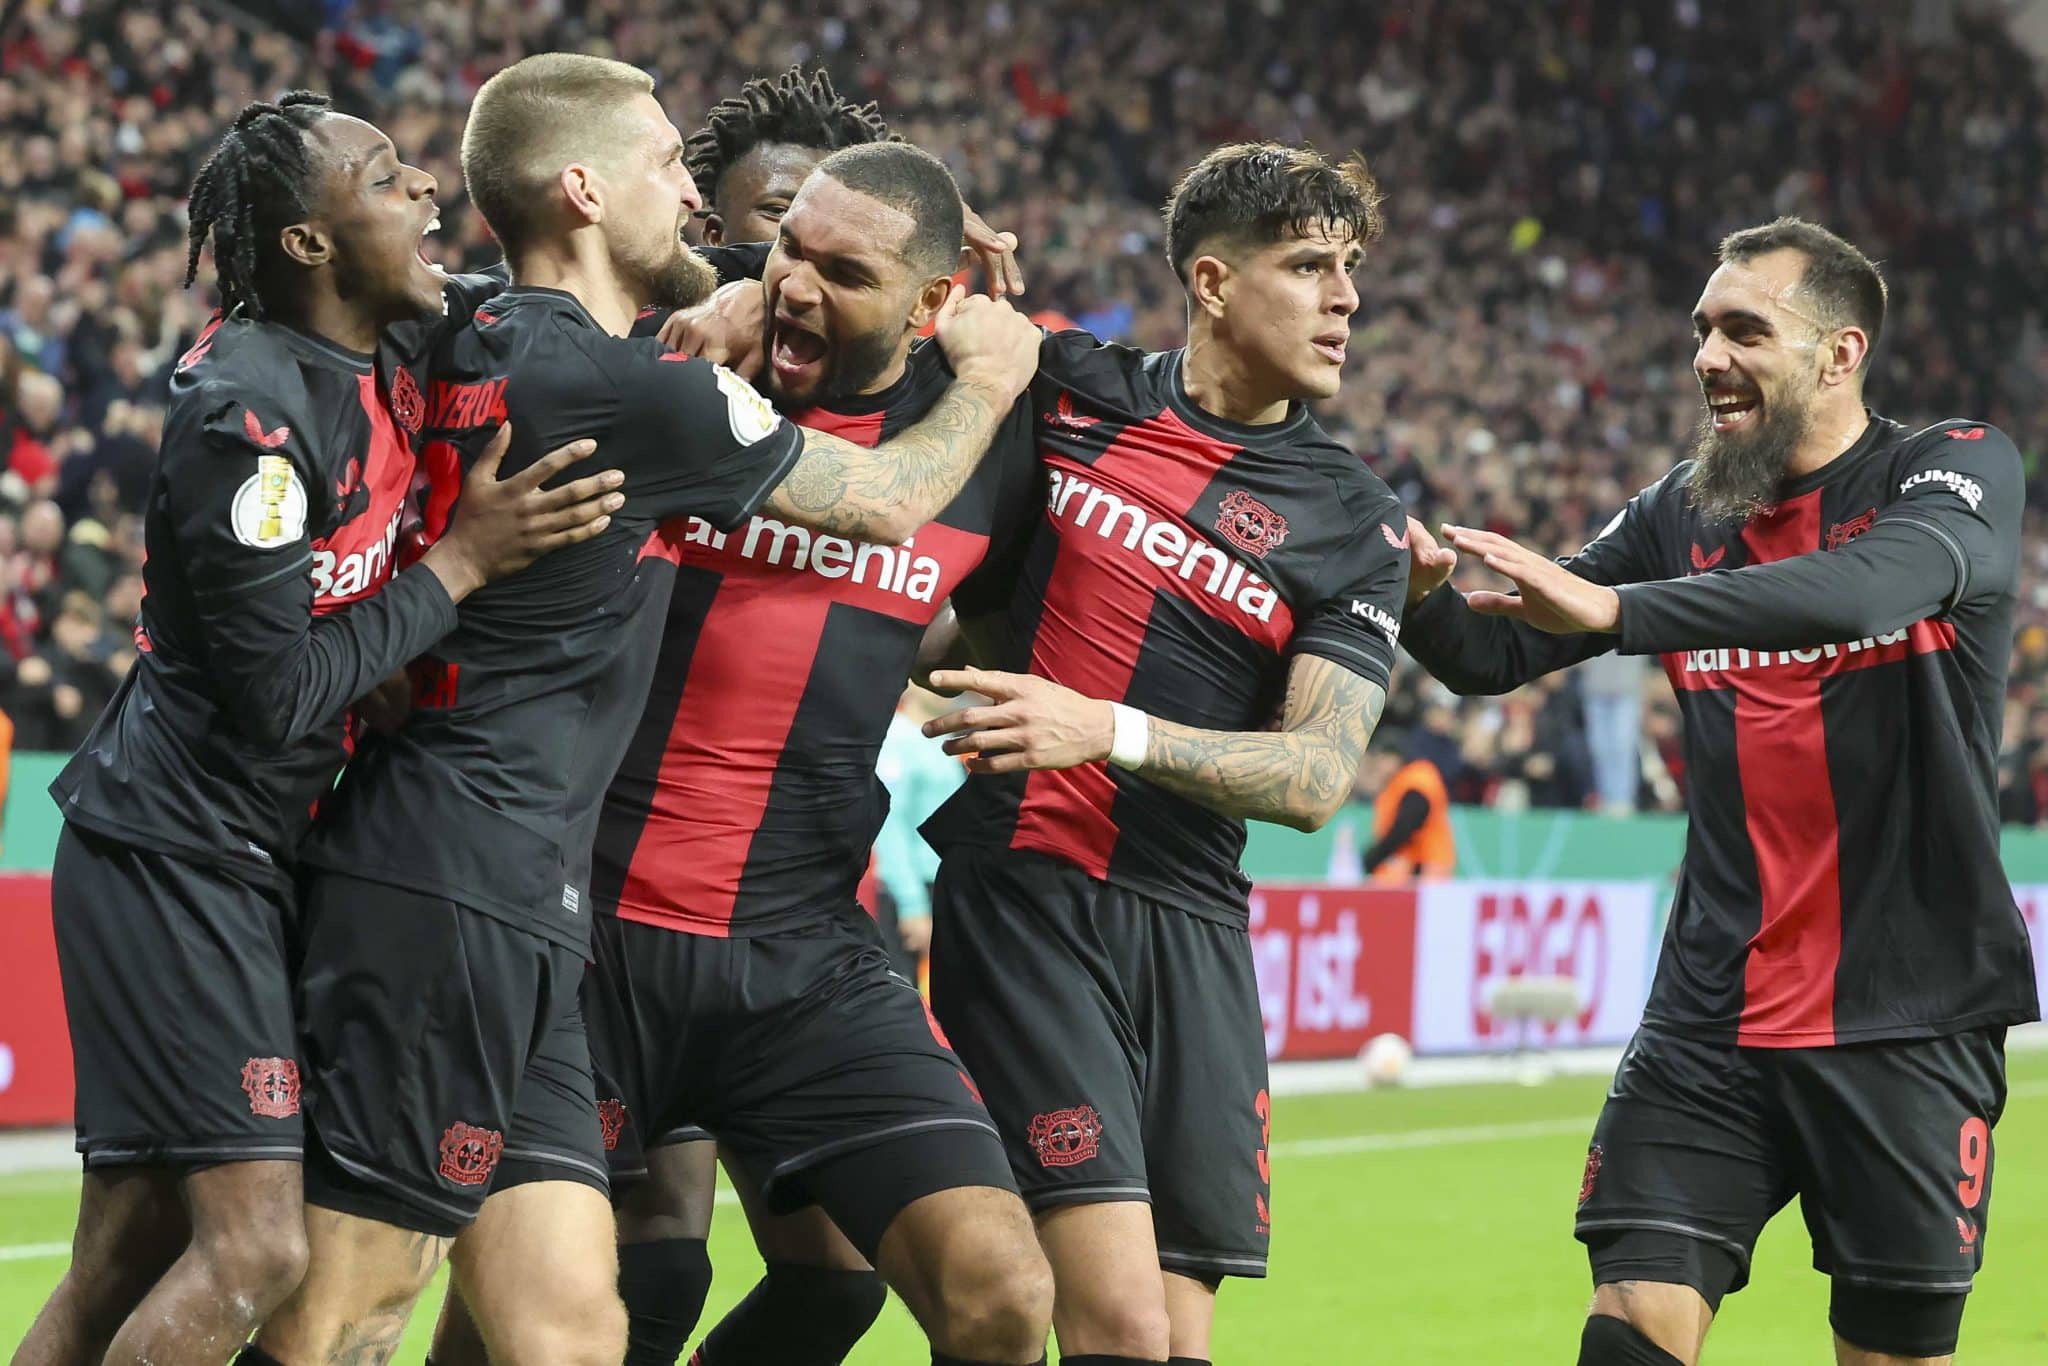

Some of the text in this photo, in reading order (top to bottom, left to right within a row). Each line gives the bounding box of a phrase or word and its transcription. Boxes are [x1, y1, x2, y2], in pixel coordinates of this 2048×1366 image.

[426, 377, 509, 428] YER04
[1900, 469, 1983, 501] KUMHO
[684, 515, 941, 604] amenia
[1049, 470, 1278, 623] armenia
[1351, 599, 1400, 639] KUMH
[1473, 893, 1609, 1037] ERGO
[1958, 1116, 1988, 1209] 9
